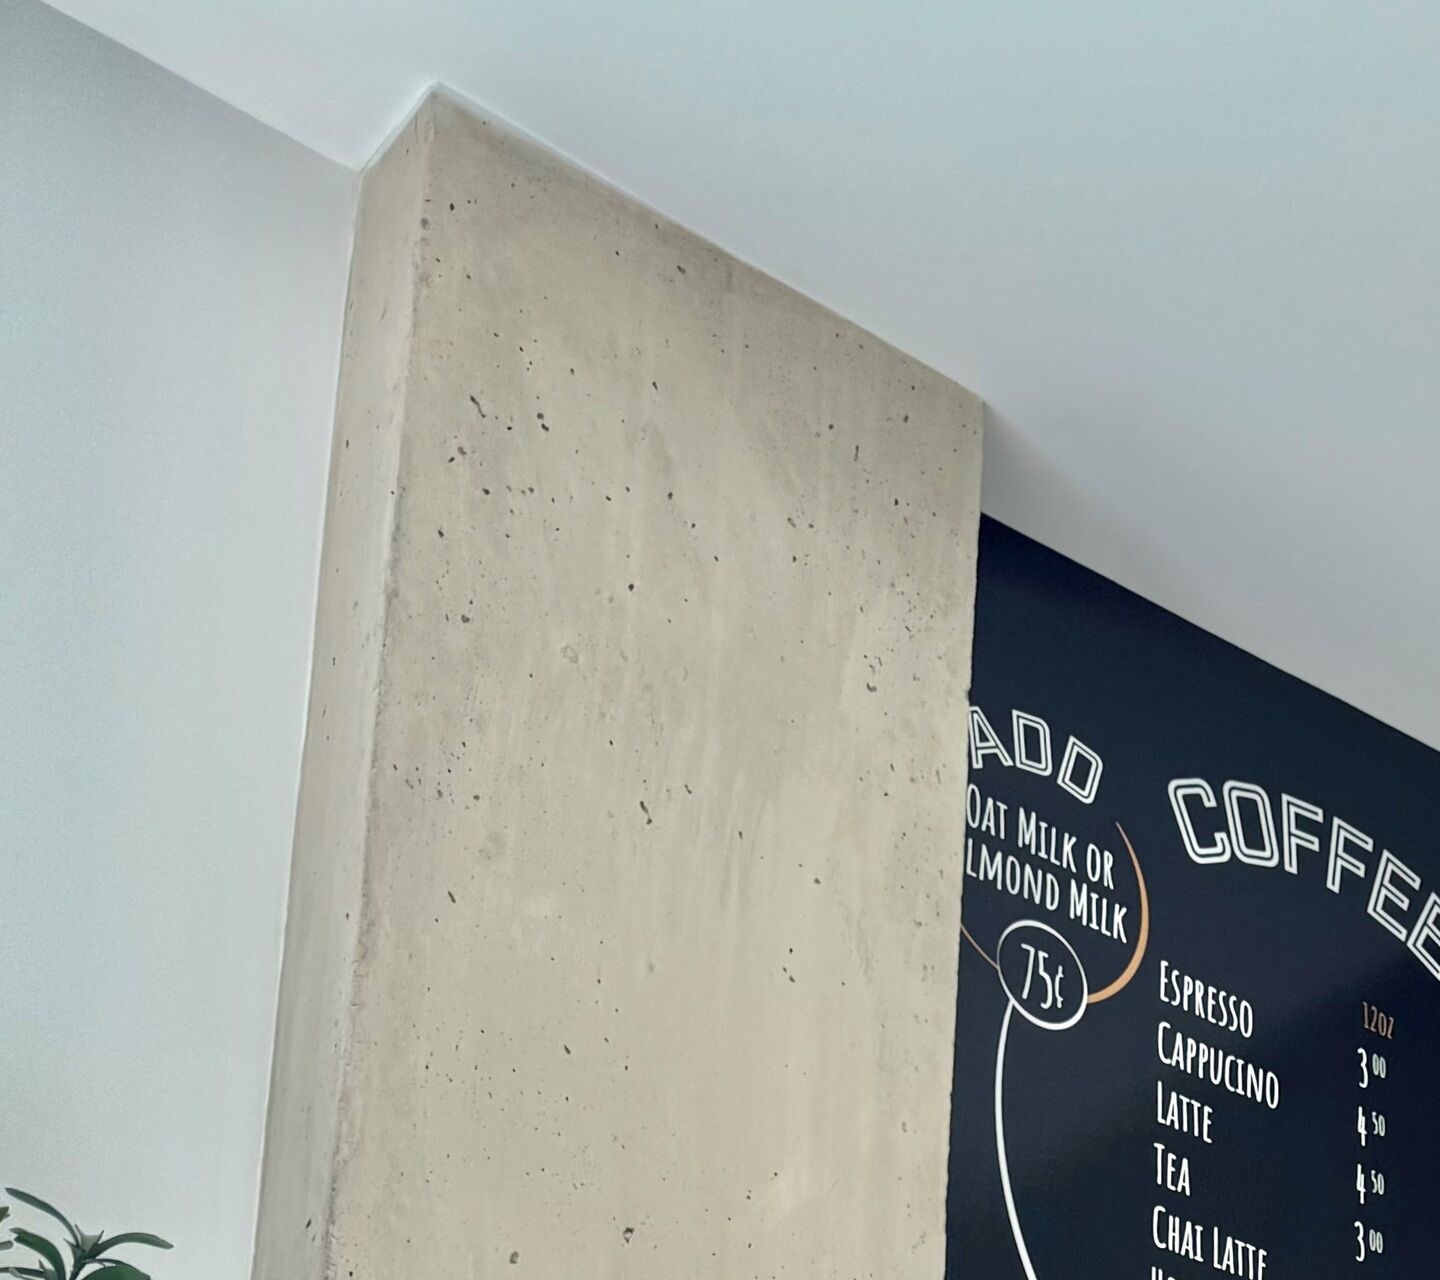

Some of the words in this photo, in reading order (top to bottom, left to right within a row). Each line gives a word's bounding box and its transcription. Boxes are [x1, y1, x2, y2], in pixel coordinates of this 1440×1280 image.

[968, 706, 1104, 805] ADD
[965, 783, 1008, 840] OAT
[1018, 806, 1077, 874] MILK
[1086, 842, 1115, 890] OR
[965, 837, 1060, 911] LMOND
[1069, 878, 1128, 944] MILK
[1159, 960, 1254, 1039] ESPRESSO
[1157, 1021, 1280, 1110] CAPPUCINO
[1156, 1081, 1214, 1144] LATTE
[1153, 1142, 1191, 1197] TEA
[1152, 1205, 1204, 1264] CHAI
